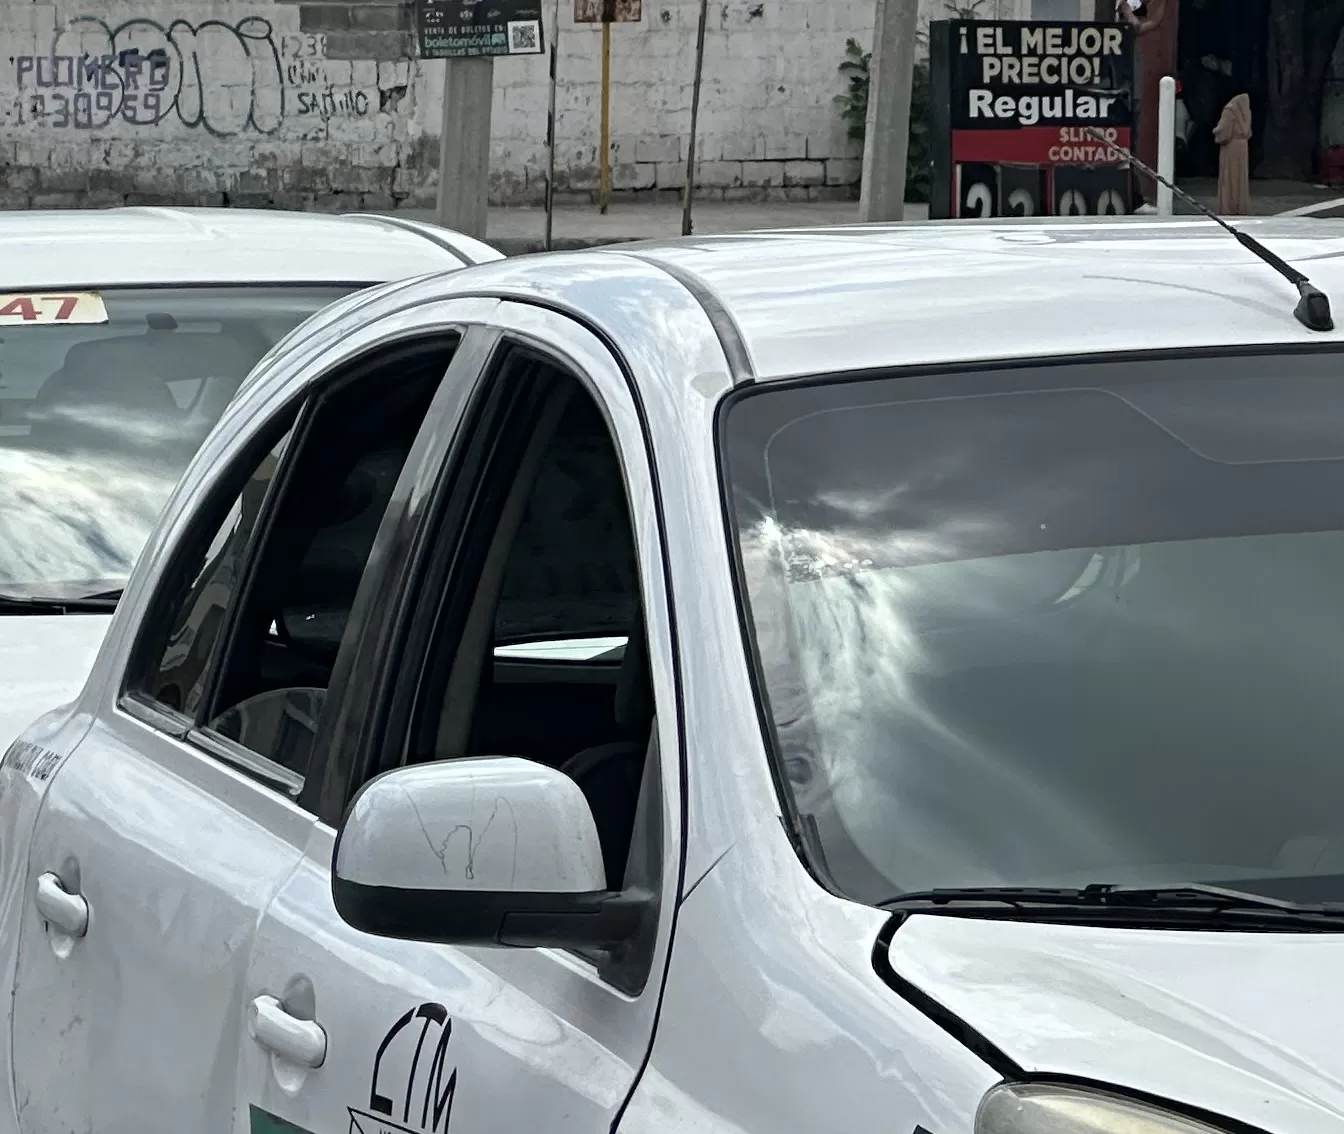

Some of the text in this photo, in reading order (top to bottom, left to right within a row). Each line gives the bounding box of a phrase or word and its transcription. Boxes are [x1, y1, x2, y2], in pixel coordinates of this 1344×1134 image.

[1021, 27, 1123, 55] MEJOR
[982, 56, 1101, 84] PRECIO!
[968, 89, 1116, 125] Regular
